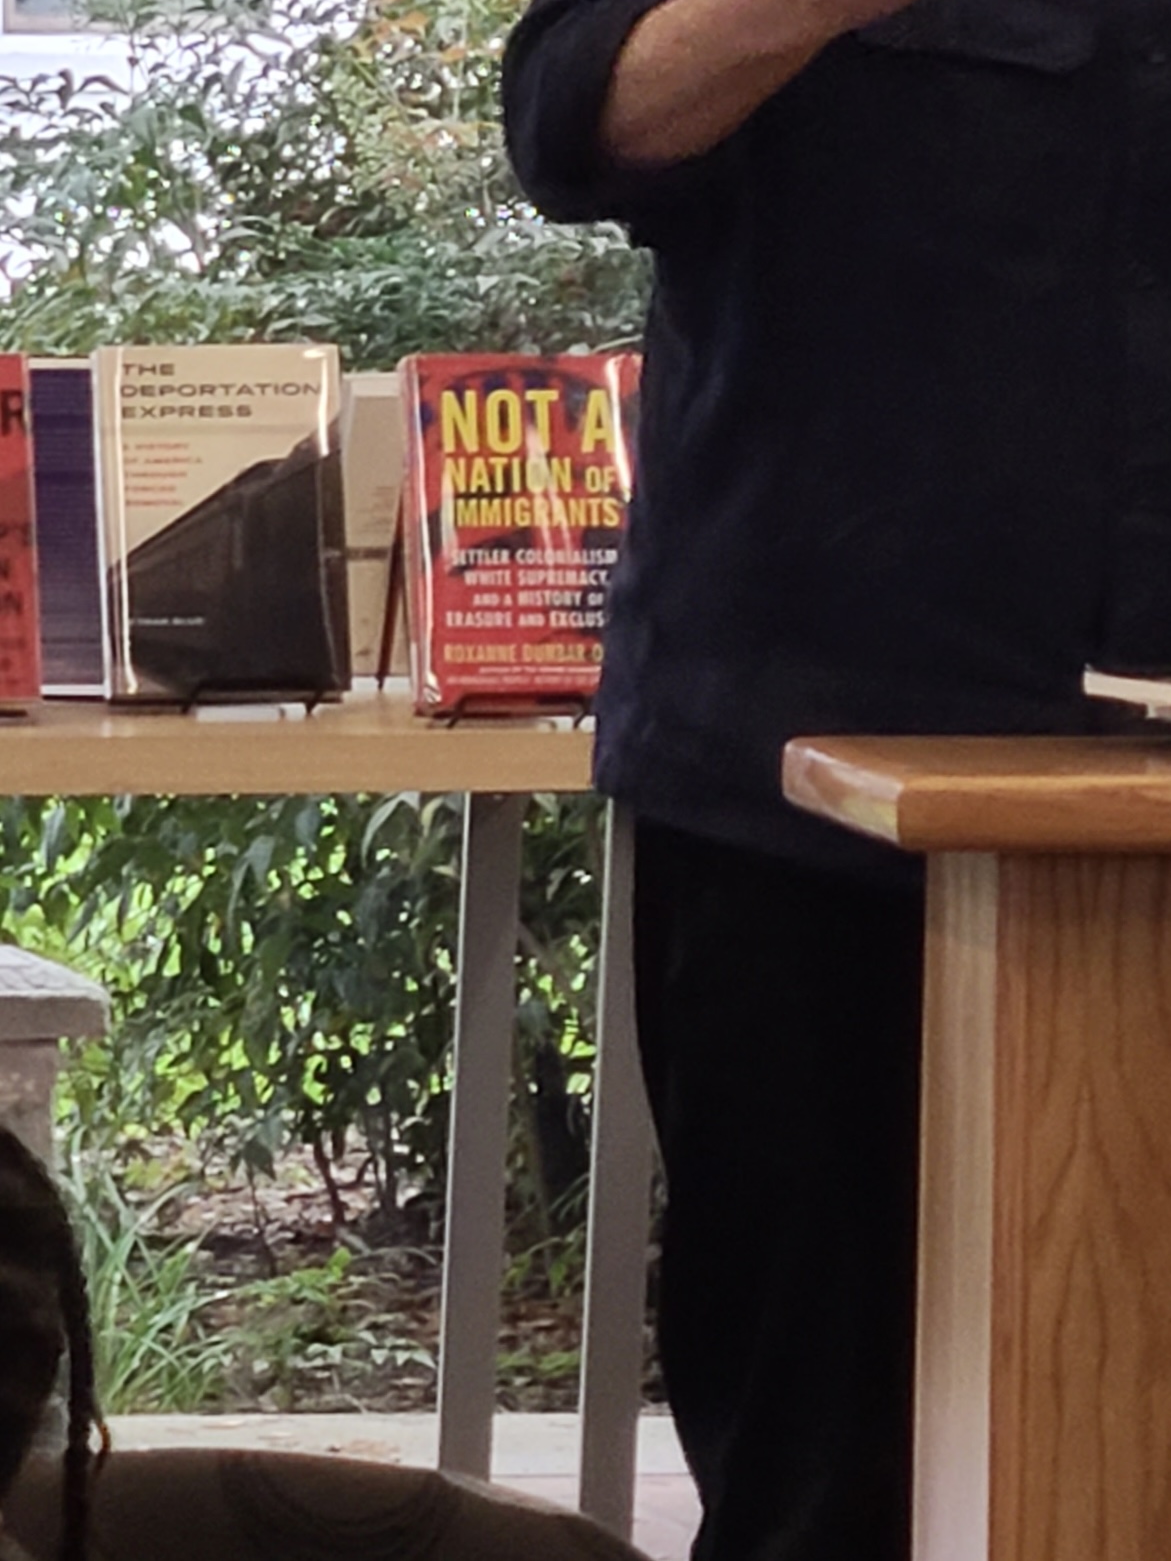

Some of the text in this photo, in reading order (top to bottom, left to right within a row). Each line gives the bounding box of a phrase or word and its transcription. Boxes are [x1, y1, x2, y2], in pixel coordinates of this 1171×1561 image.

[122, 363, 175, 376] THE
[120, 382, 321, 398] DEPORTATION
[121, 405, 253, 419] EXPRESS
[441, 389, 617, 453] NOT A
[445, 456, 617, 493] NATION OF
[464, 569, 512, 586] WHITE
[473, 593, 499, 606] AND
[503, 593, 513, 606] A
[517, 591, 582, 606] HISTORY
[446, 611, 605, 628] ERASURE AND EXCLUS
